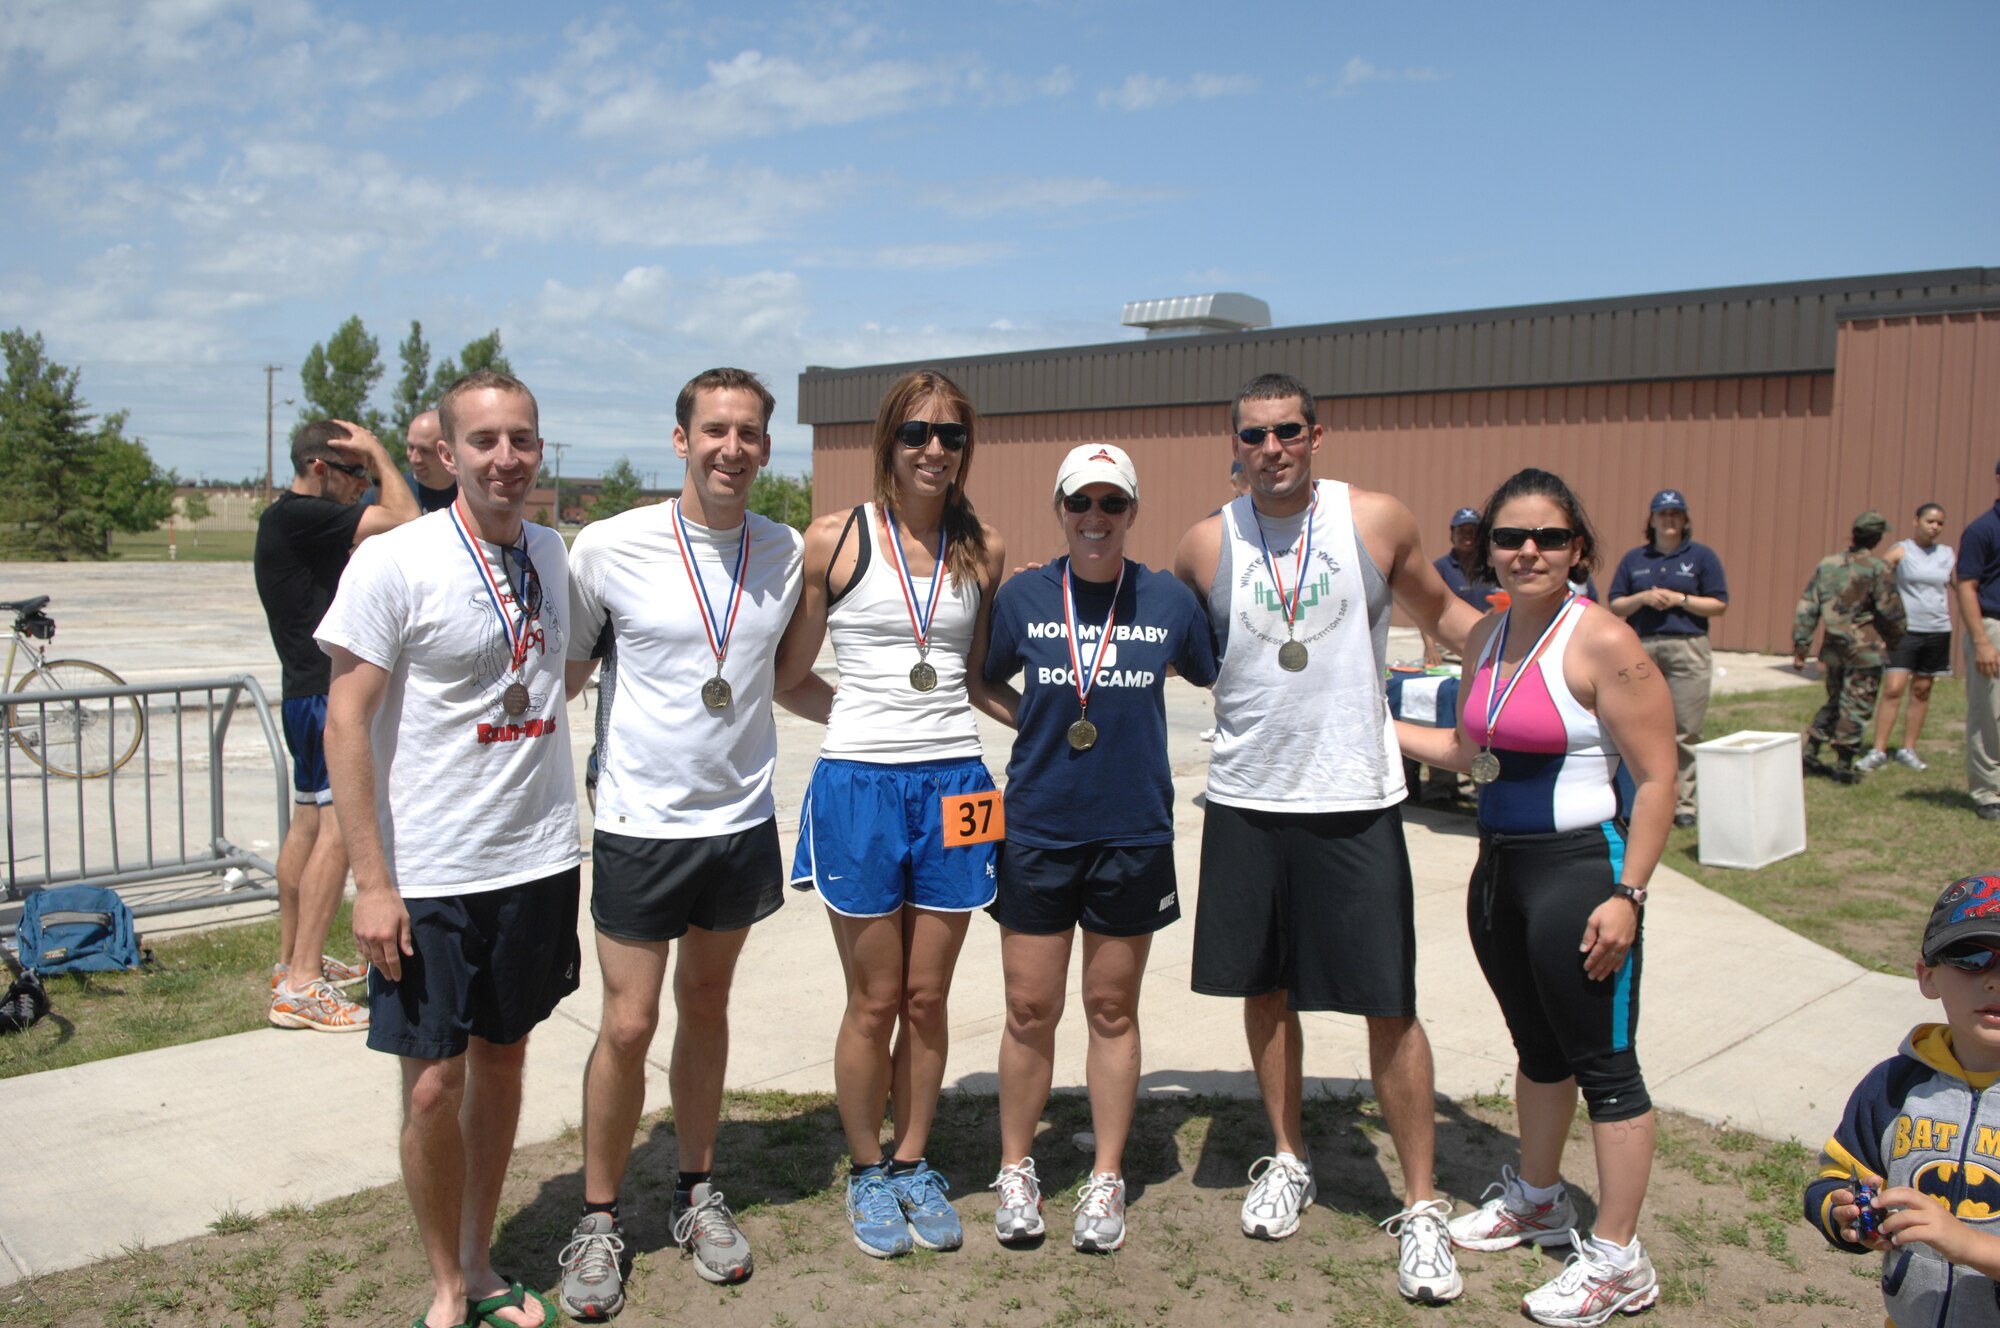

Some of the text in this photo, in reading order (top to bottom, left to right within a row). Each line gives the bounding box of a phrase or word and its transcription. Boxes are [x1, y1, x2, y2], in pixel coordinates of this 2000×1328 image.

[1240, 554, 1267, 588] WINTE
[1317, 550, 1341, 575] YMCA
[1240, 611, 1258, 634] BENCH
[1257, 633, 1285, 646] PRESS
[1299, 617, 1342, 645] MPETITION
[1038, 667, 1155, 688] BOO CAMP
[959, 799, 993, 837] 37
[1892, 1114, 1959, 1159] BAT
